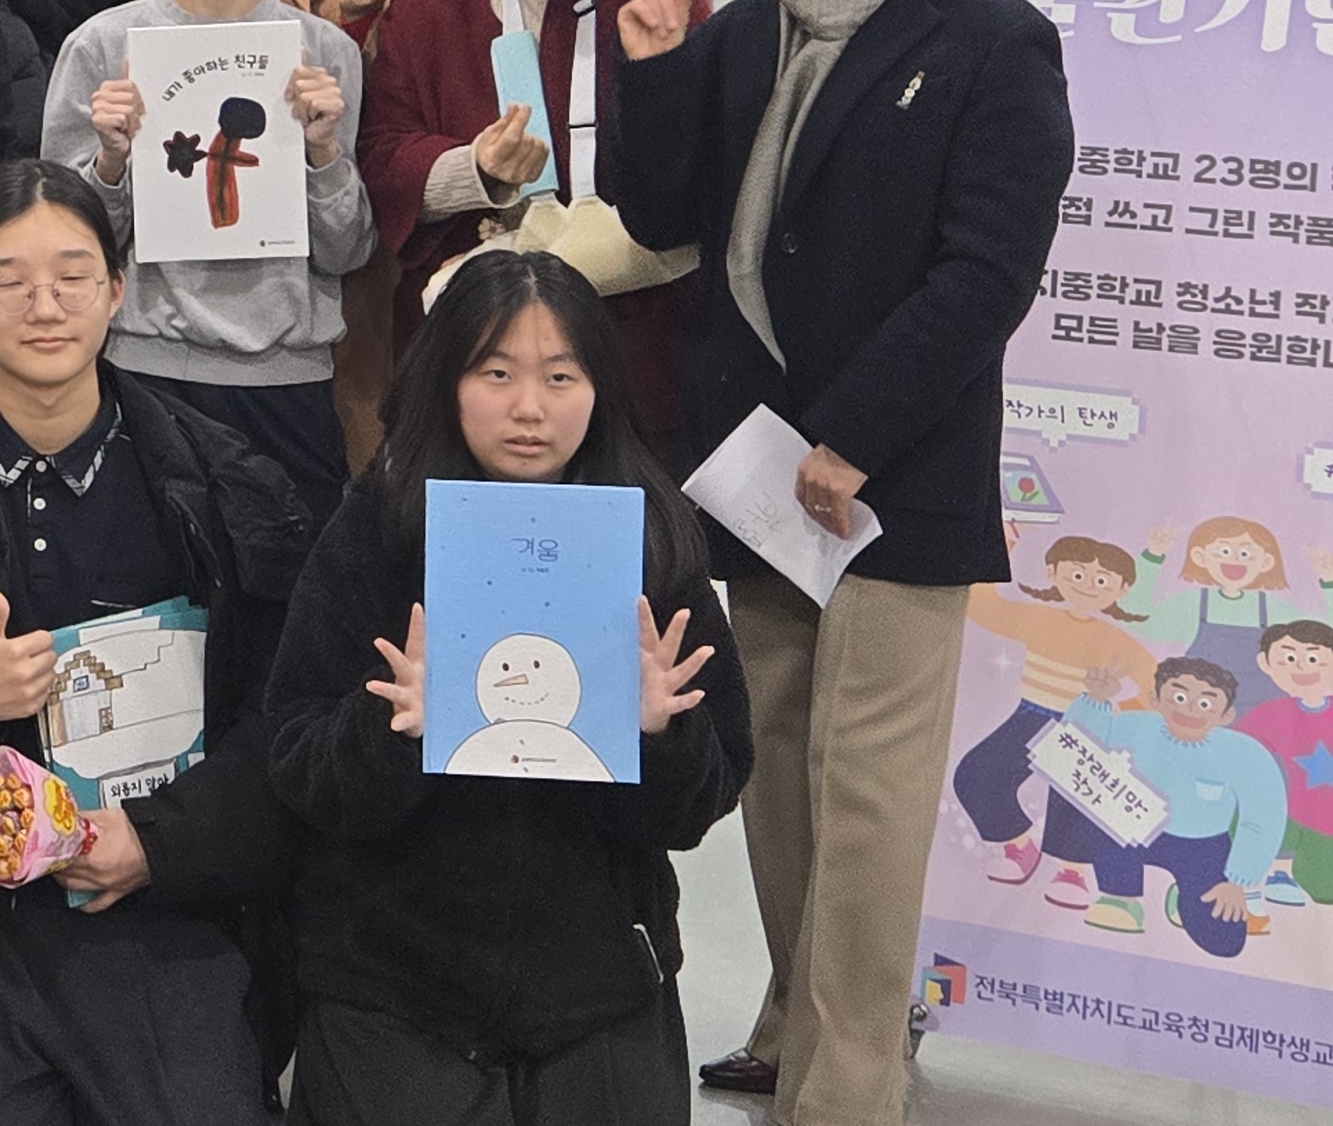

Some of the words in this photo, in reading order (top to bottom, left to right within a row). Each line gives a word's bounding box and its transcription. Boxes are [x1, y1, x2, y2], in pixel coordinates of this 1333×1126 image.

[162, 81, 183, 102] 내가
[182, 57, 230, 84] 좋아하는
[233, 54, 269, 70] 친구들
[1077, 145, 1181, 181] 중학교
[1193, 154, 1319, 193] 23명의
[1059, 195, 1094, 226] 접
[1104, 200, 1174, 232] 쓰고
[1185, 206, 1256, 239] 그린
[1176, 281, 1282, 320] 청소년
[1051, 313, 1120, 346] 모든
[1132, 321, 1201, 355] 날을
[1005, 399, 1065, 424] 작가의
[1077, 406, 1119, 430] 탄생
[1072, 769, 1102, 805] 작가
